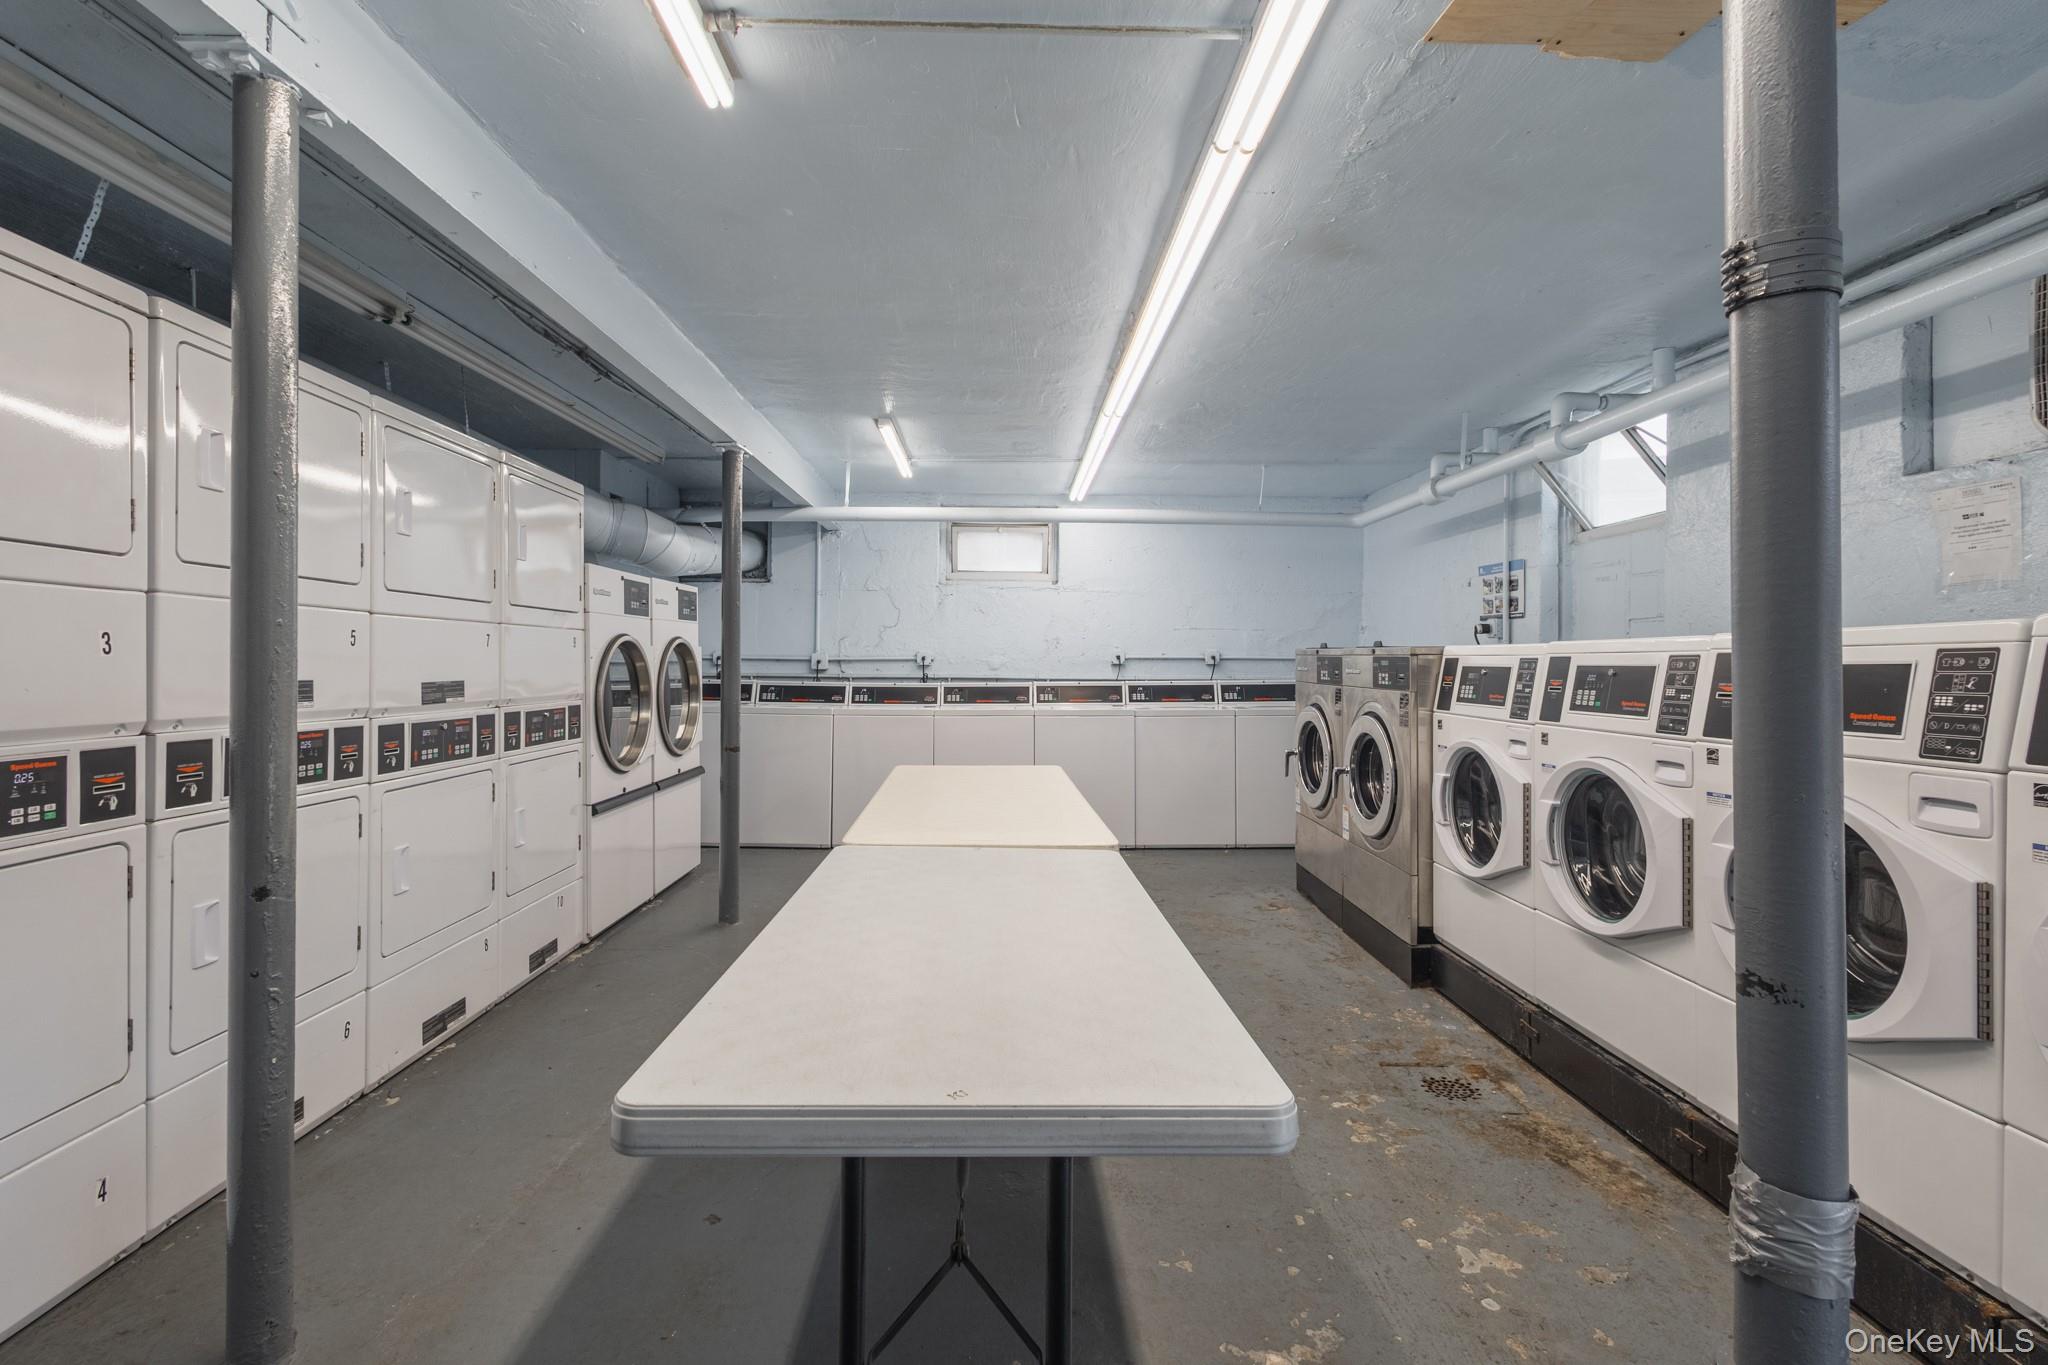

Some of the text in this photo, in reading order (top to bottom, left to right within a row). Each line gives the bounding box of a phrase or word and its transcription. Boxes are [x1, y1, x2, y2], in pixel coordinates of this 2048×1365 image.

[101, 631, 112, 655] 3
[350, 629, 356, 647] 5
[344, 1021, 351, 1039] 6
[97, 1177, 107, 1202] 4
